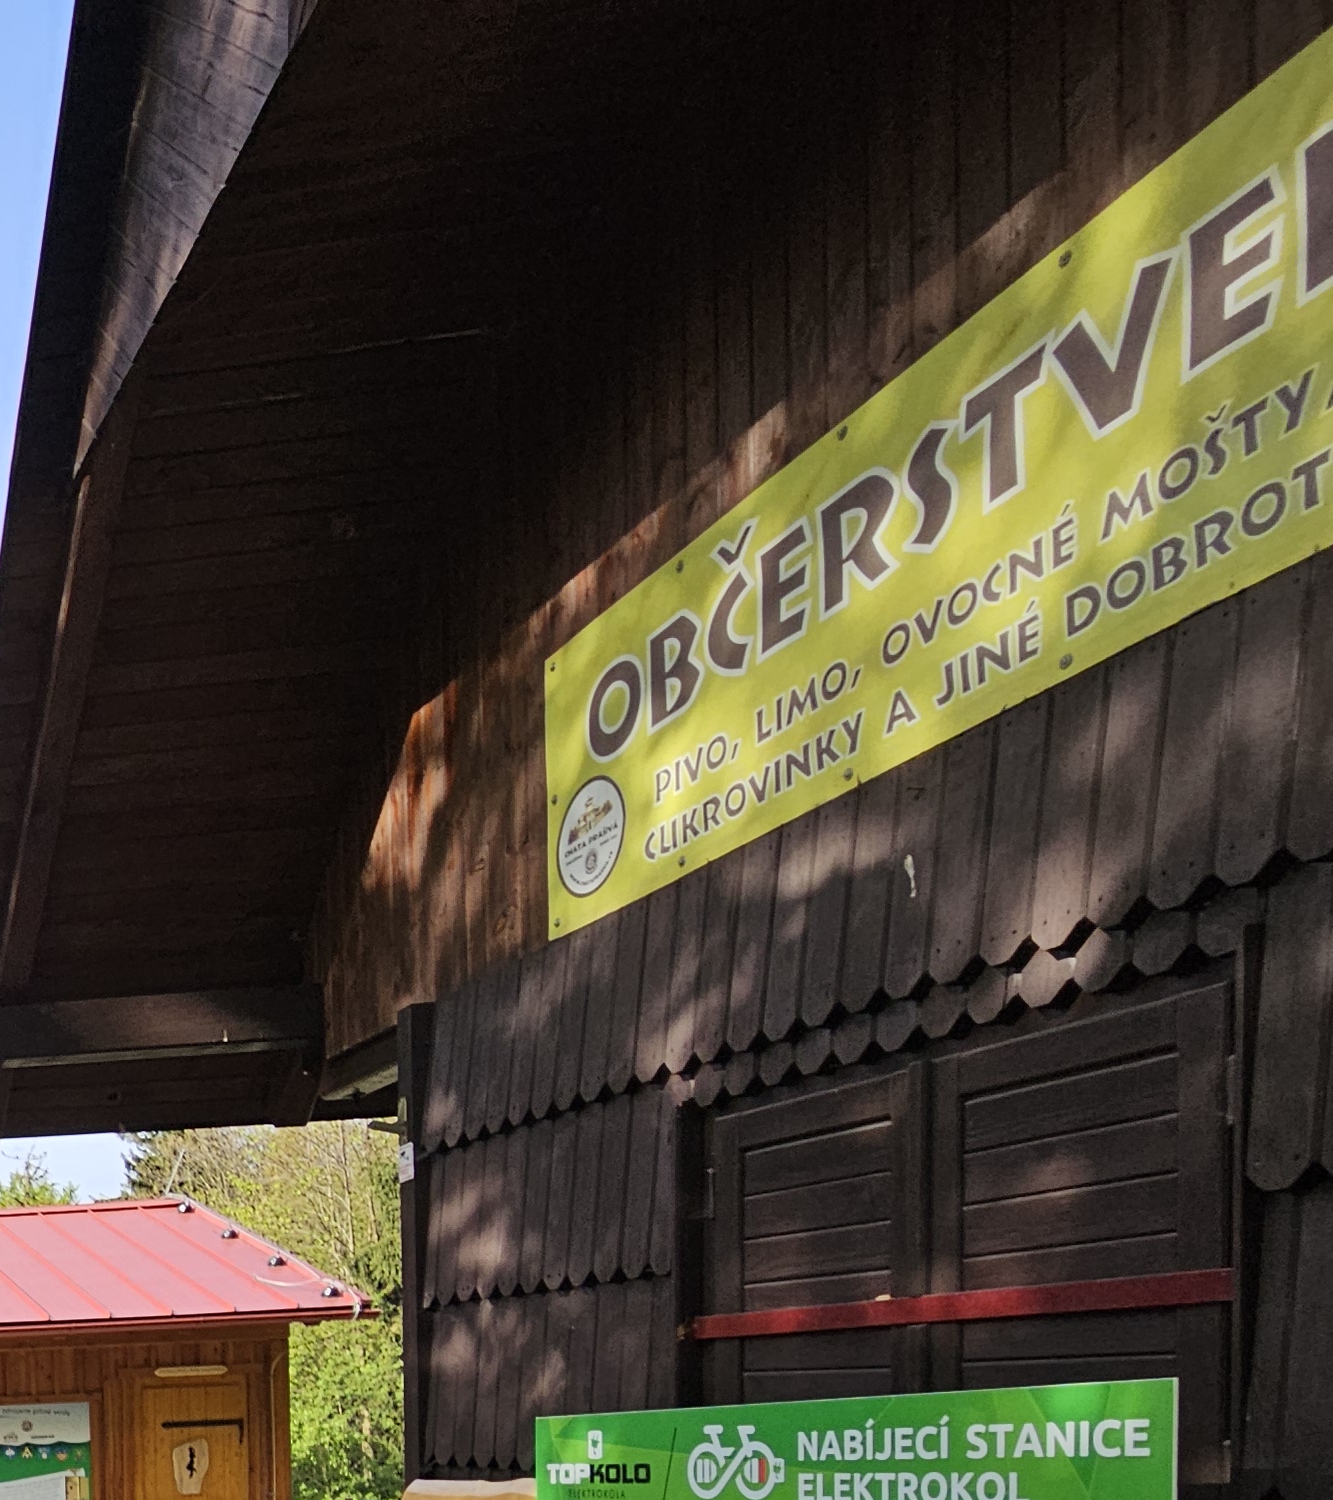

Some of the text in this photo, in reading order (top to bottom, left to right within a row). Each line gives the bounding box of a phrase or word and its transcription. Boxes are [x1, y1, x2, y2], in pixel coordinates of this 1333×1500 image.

[654, 367, 1318, 802] PIVO, LIMO, OVOCNÉ MOŠTY
[644, 712, 863, 860] CUKROVINKY
[885, 690, 917, 735] A
[936, 602, 1042, 706] JINÉ
[797, 1415, 1151, 1462] NABÍJECÍ STANICE
[547, 1463, 651, 1485] TOPKOLO
[568, 1488, 626, 1499] ELEKTROKOLA
